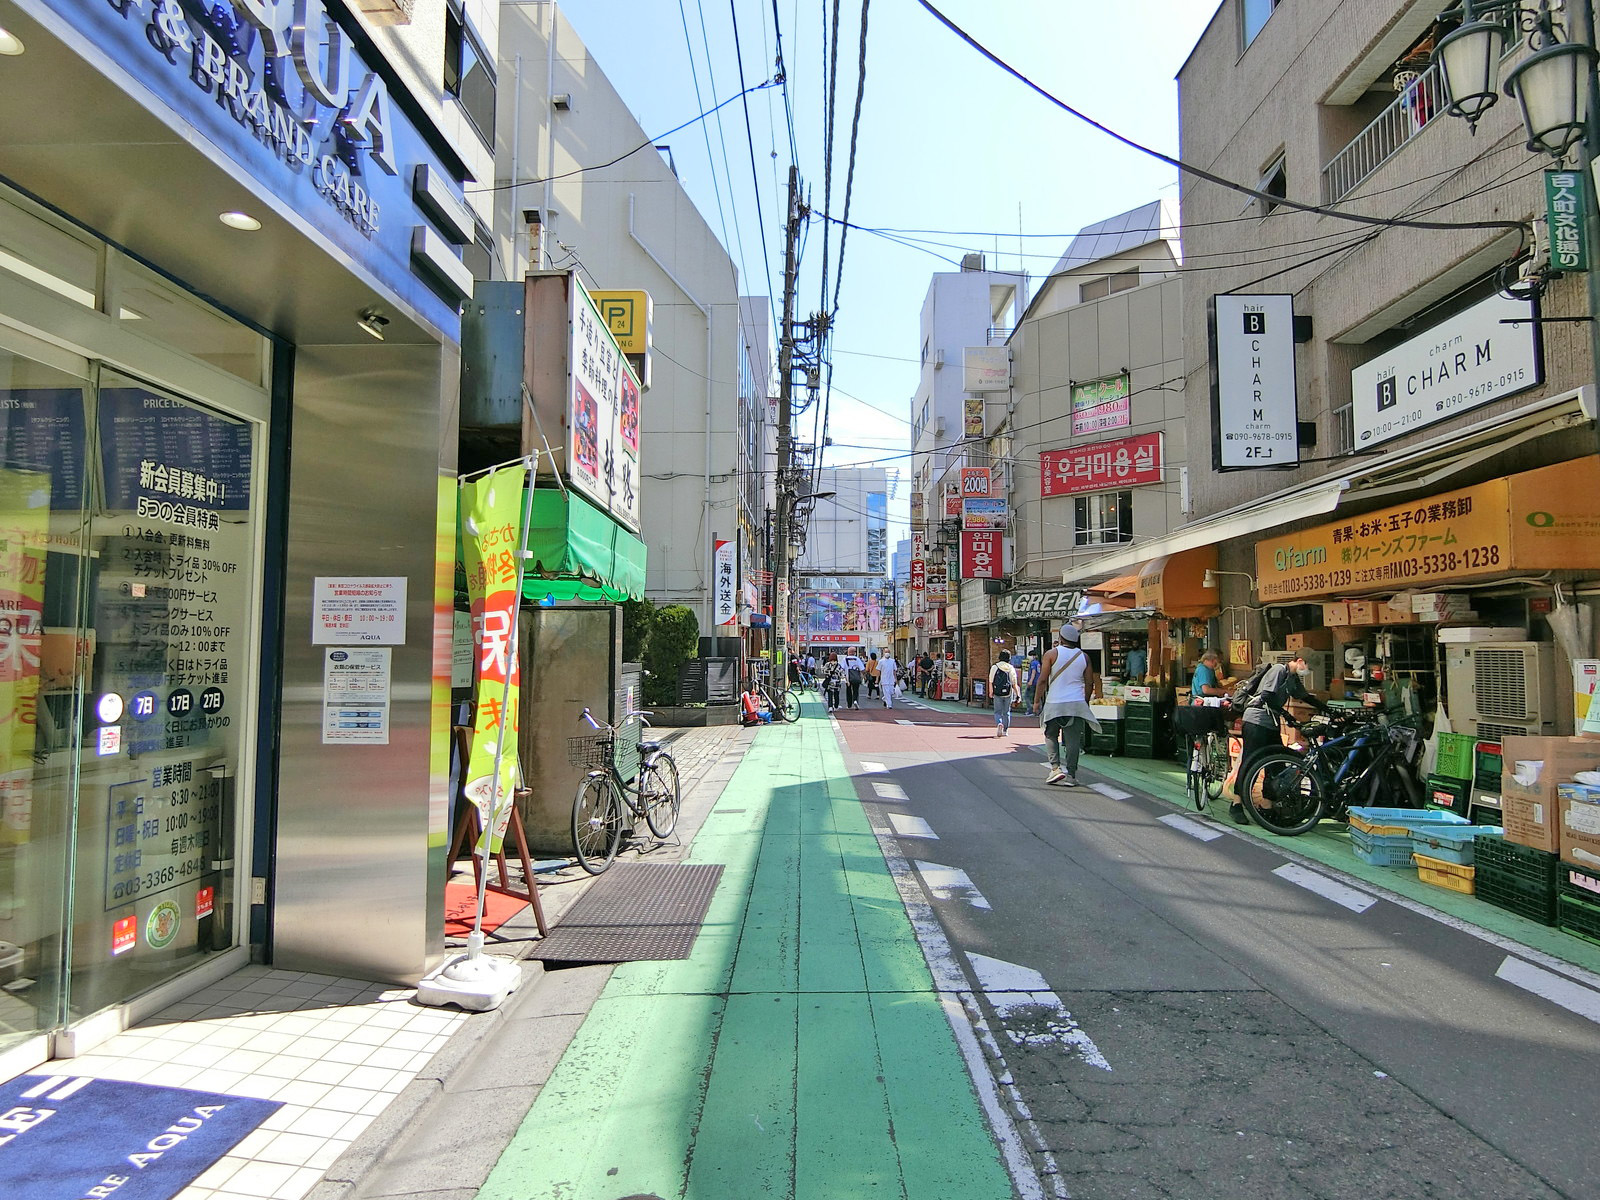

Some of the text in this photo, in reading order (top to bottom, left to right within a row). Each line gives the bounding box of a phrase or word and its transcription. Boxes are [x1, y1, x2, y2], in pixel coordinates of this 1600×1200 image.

[202, 30, 314, 166] BRAND
[319, 154, 381, 232] CARE
[1550, 174, 1580, 268] 百人町文化通り
[608, 307, 626, 330] P
[1243, 303, 1264, 312] hair
[617, 320, 625, 329] 24
[1250, 315, 1260, 332] B
[1429, 334, 1463, 357] charm
[1251, 339, 1263, 421] CHARM
[1376, 364, 1396, 382] hair
[1382, 338, 1492, 406] B CHARM
[143, 398, 170, 408] PRICE
[1372, 421, 1392, 437] 10:00
[1401, 409, 1422, 426] 21:00
[1445, 367, 1525, 408] 090-9678-0915
[1234, 432, 1293, 441] 090-9678-0915
[1245, 446, 1262, 458] 2F
[1056, 445, 1154, 484] 우리미용실
[964, 476, 988, 494] 200円
[137, 496, 220, 533] 5つの会員特典
[1332, 496, 1472, 545] 青果・お米・玉子の業務卸
[972, 532, 993, 541] 우리
[222, 562, 237, 574] OFF
[972, 542, 993, 577] 미용실
[1274, 545, 1327, 571] Qfarm
[134, 563, 208, 584] チケットプレゼント
[912, 562, 924, 588] 王将
[720, 562, 732, 615] 海外送金
[214, 626, 230, 638] OFF
[137, 692, 221, 715] 7日 17日 27日
[152, 761, 193, 788] 営業時間
[114, 849, 142, 874] 定休日
[128, 1104, 226, 1169] AQUA
